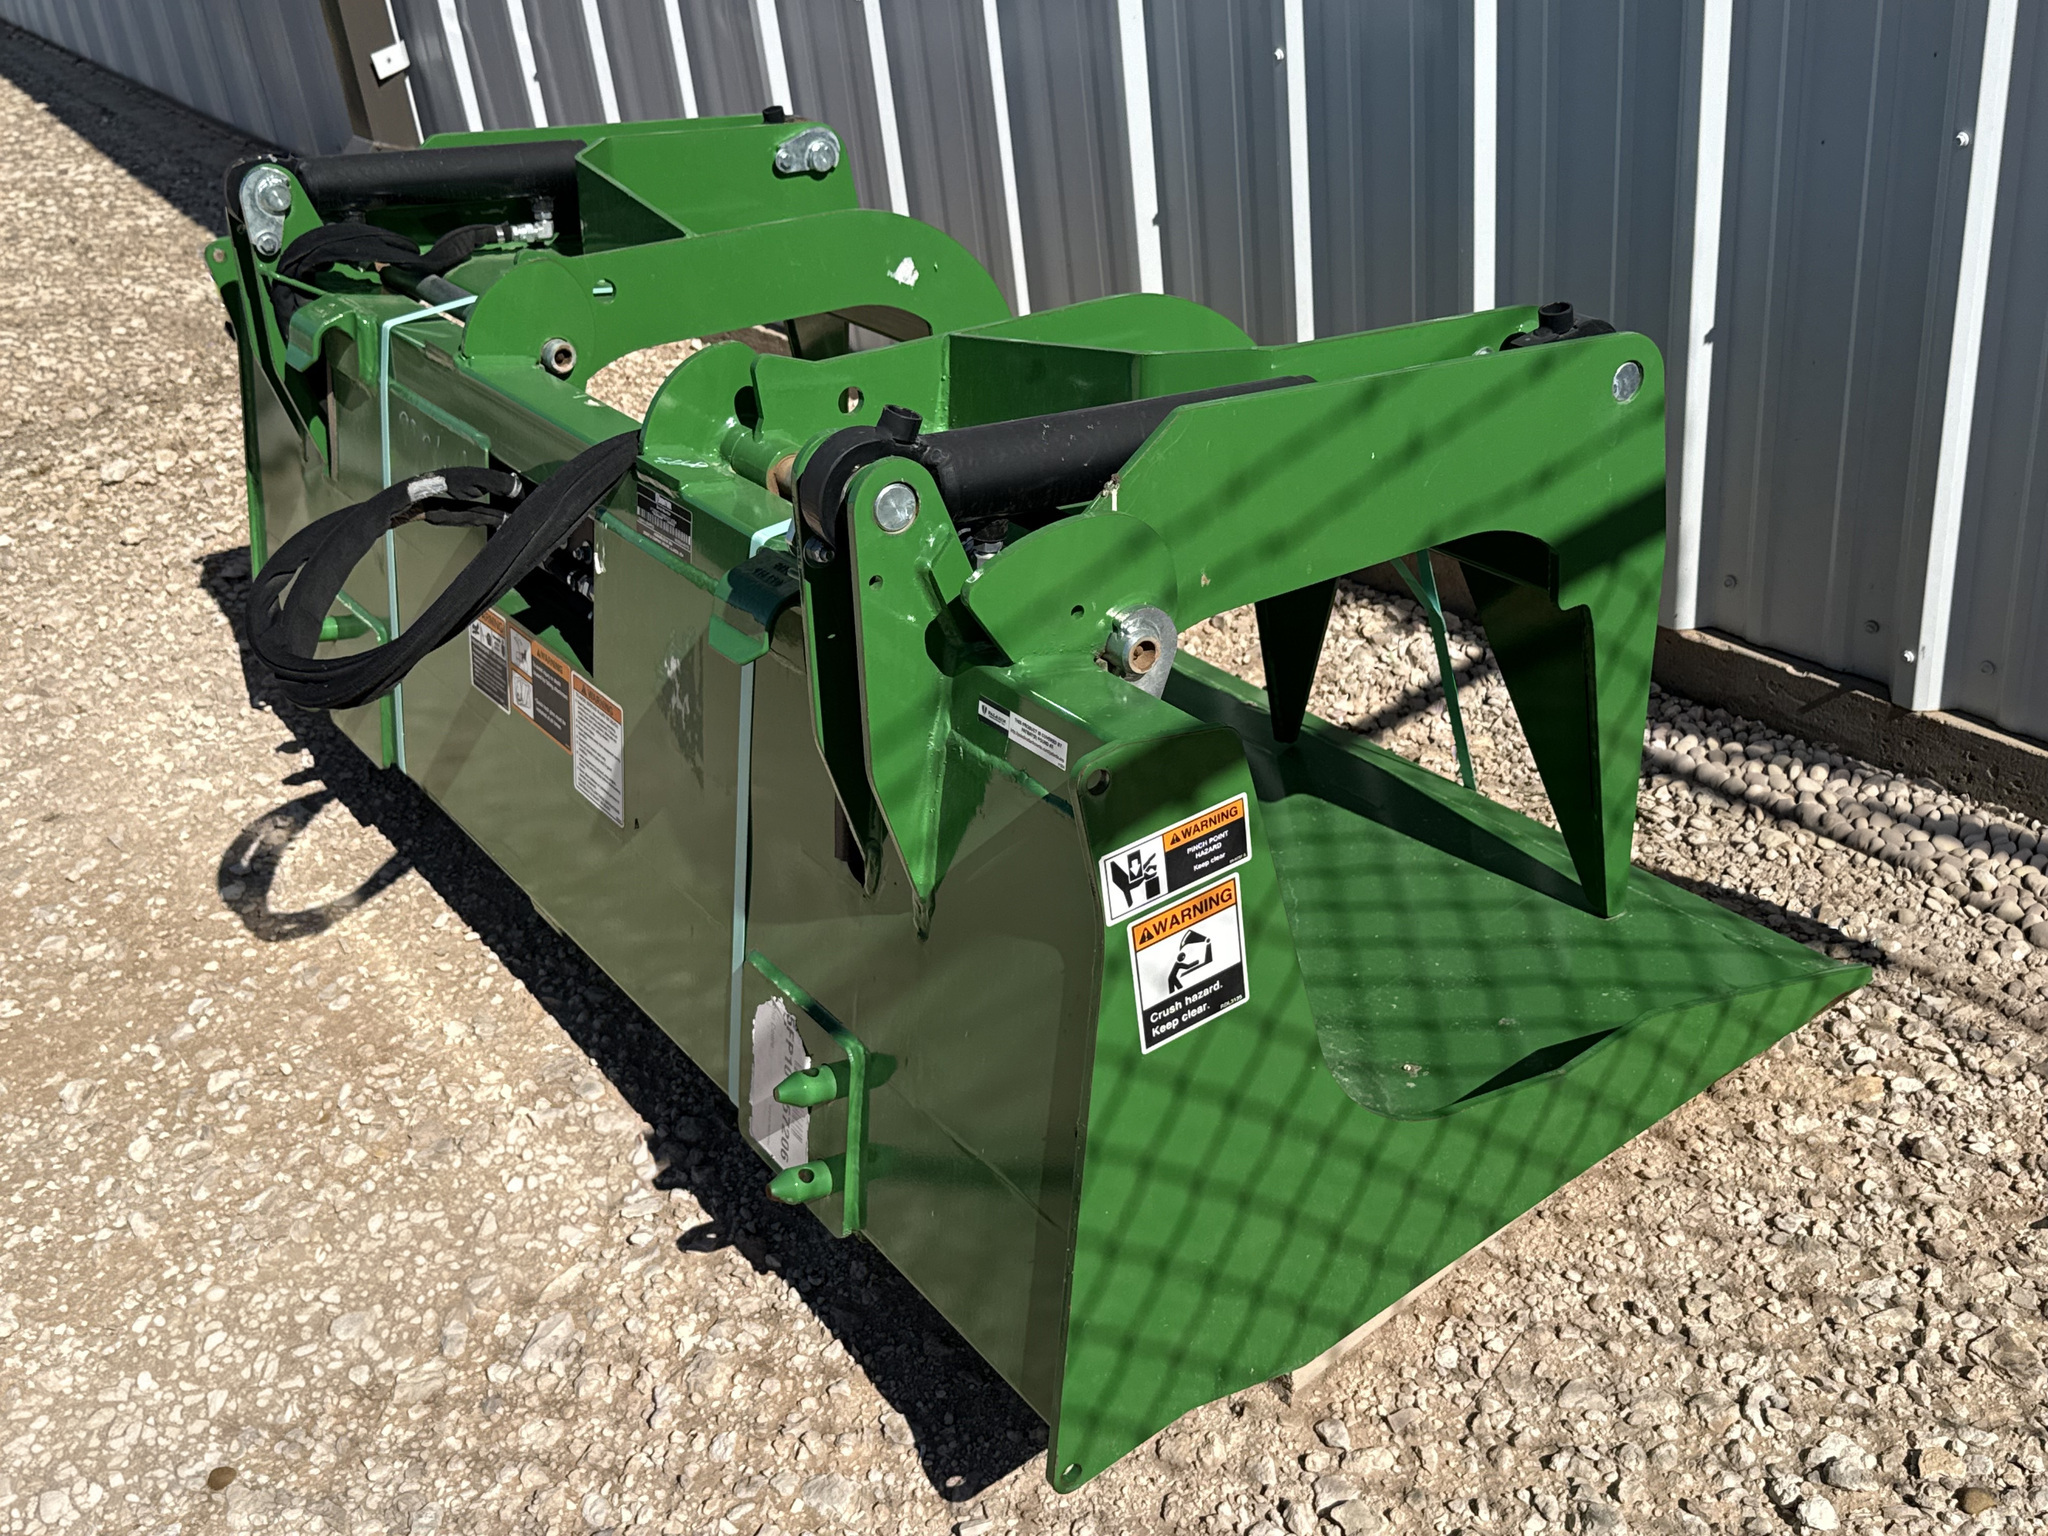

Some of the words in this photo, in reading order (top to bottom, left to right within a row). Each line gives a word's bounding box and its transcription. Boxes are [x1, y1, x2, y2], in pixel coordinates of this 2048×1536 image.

[1181, 806, 1239, 840] WARNING
[1186, 839, 1208, 854] PINCH
[1208, 829, 1229, 845] POINT
[1195, 842, 1222, 859] HAZARD
[1193, 860, 1210, 872] Keep
[1210, 852, 1226, 864] clear
[1152, 887, 1233, 935] WARNING
[1150, 999, 1182, 1023] Crush
[1184, 980, 1223, 1006] hazard.
[1151, 1018, 1179, 1037] Keep
[1181, 1002, 1211, 1023] clear.
